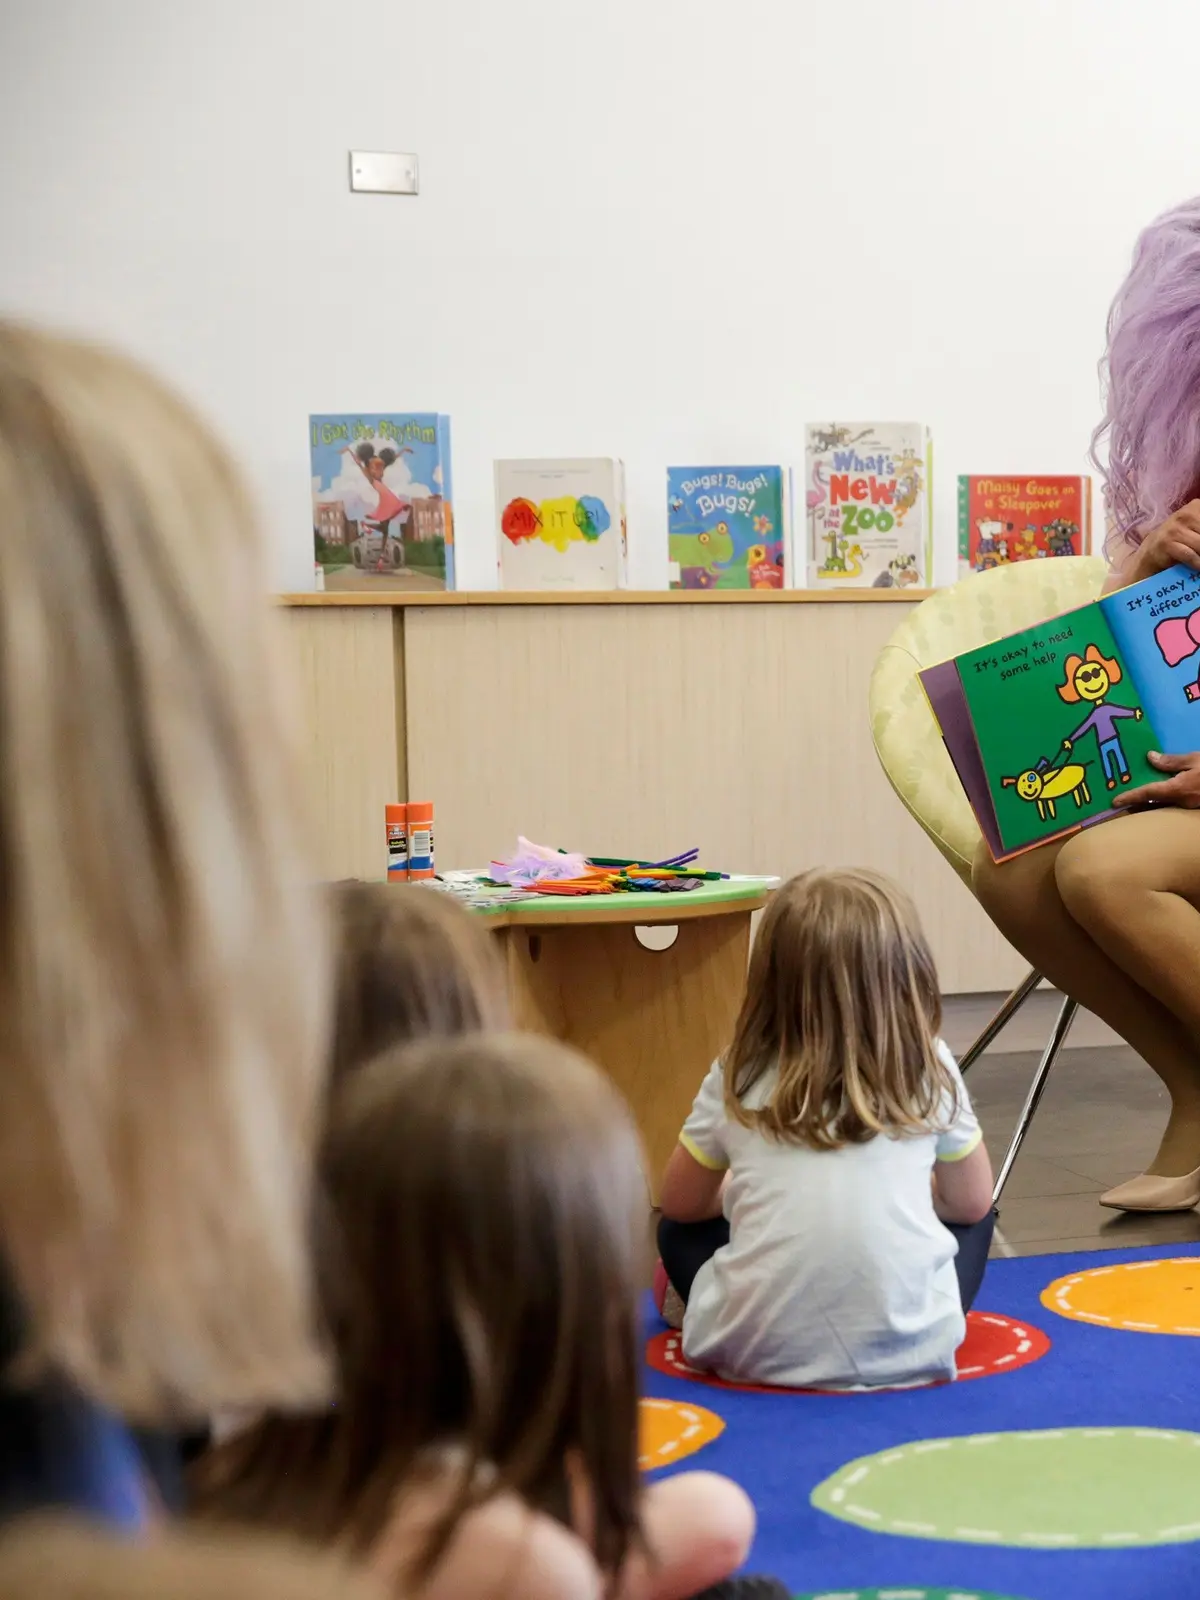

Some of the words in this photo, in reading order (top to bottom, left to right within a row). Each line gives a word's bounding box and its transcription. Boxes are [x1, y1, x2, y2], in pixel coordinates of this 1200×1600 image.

[378, 419, 436, 445] Rhythm
[833, 449, 895, 476] What's
[681, 473, 724, 496] Bugs!
[725, 473, 768, 494] Bugs!
[976, 479, 1020, 498] Maisy
[1025, 479, 1059, 496] Goes
[696, 493, 756, 518] Bugs!
[984, 498, 994, 509] a
[998, 494, 1062, 517] Sleepover
[1126, 595, 1153, 612] It's
[1156, 579, 1185, 598] okay
[973, 657, 998, 673] It's
[1001, 646, 1028, 663] okay
[1032, 640, 1045, 650] to
[1048, 626, 1074, 645] need
[1000, 662, 1031, 681] some
